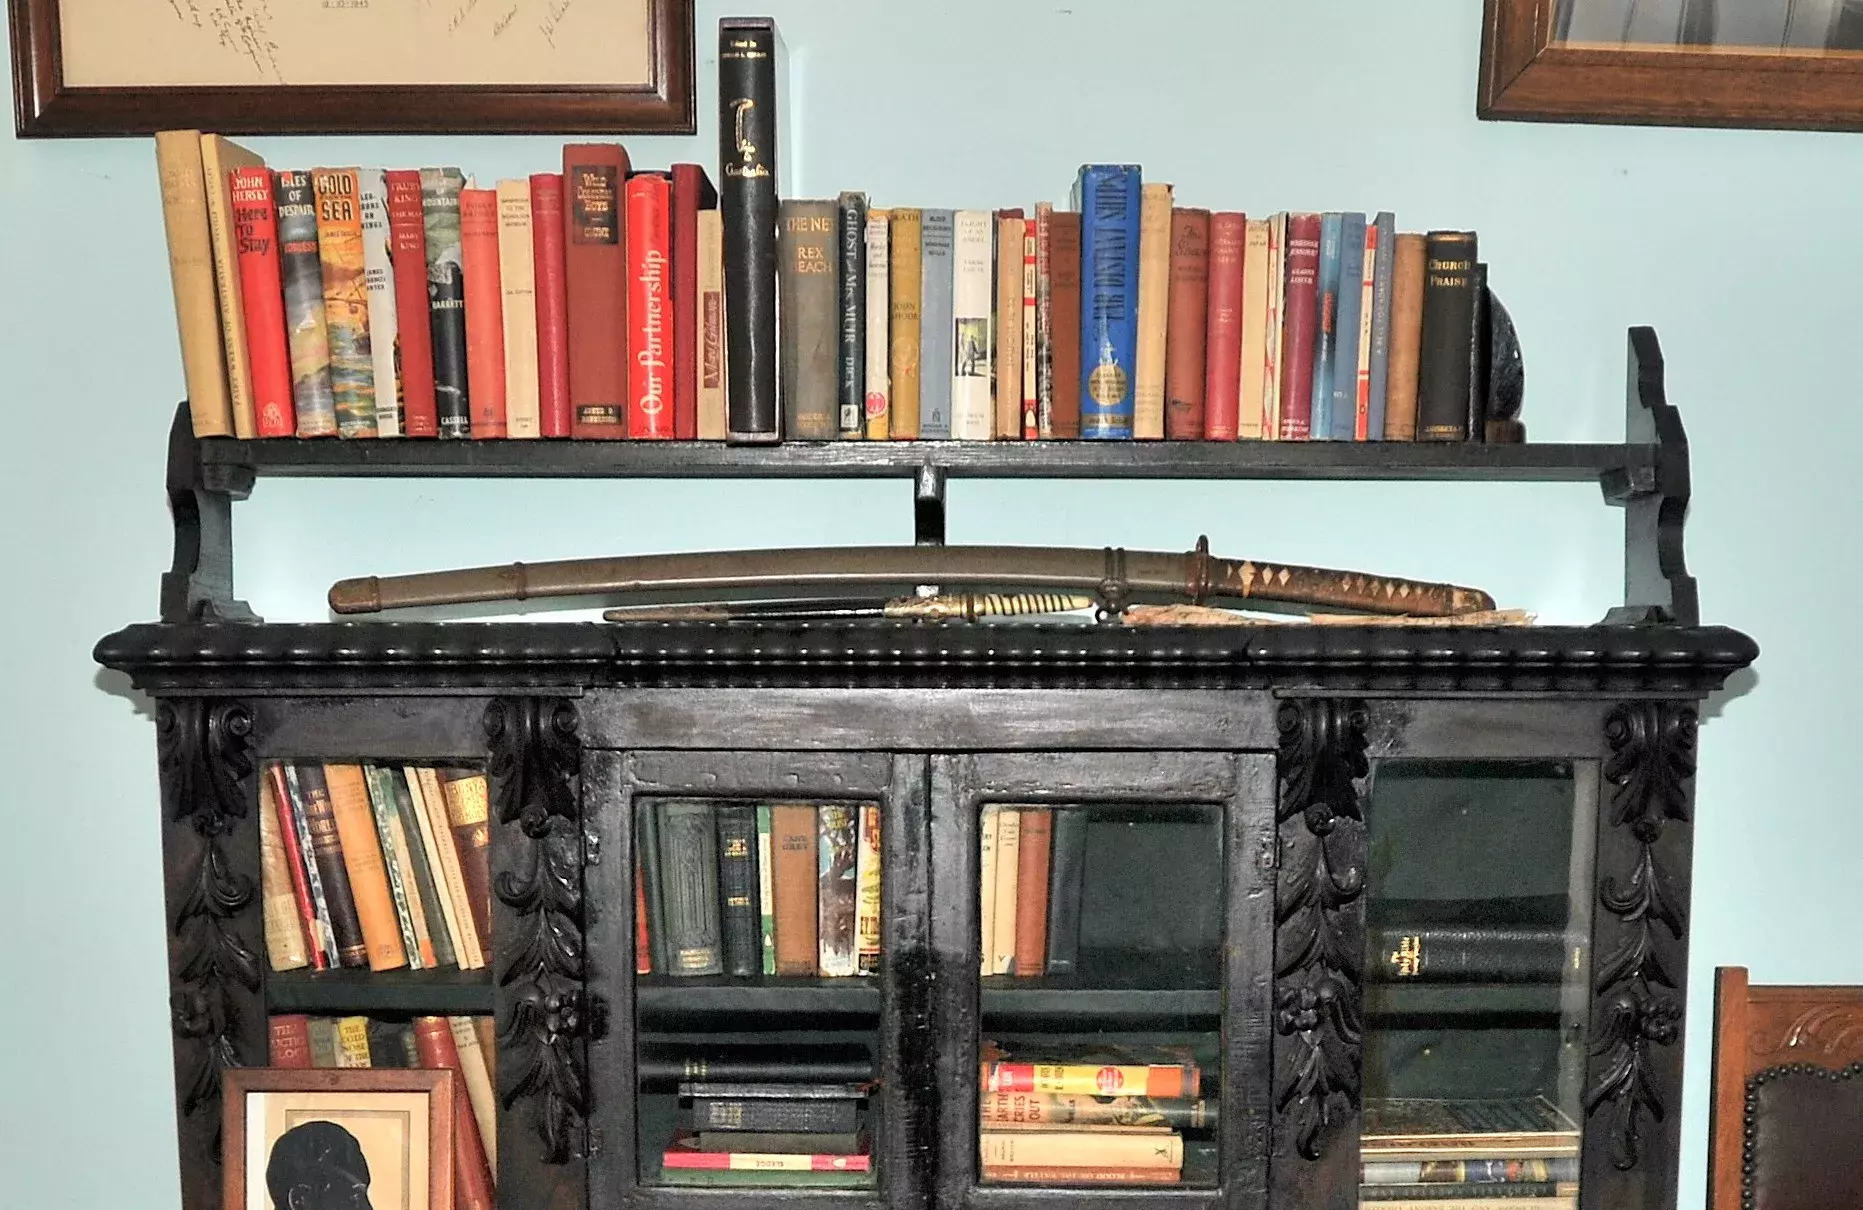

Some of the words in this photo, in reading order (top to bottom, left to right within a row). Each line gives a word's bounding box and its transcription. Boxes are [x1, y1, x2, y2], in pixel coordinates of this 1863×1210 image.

[234, 176, 263, 190] JOHN
[318, 174, 352, 195] GOLD
[288, 190, 302, 202] OF
[585, 201, 609, 211] BOYS
[1095, 175, 1127, 221] SHIPS
[278, 204, 316, 219] DESPAIR
[321, 200, 353, 221] SEA
[787, 217, 808, 232] THE
[845, 209, 858, 260] GHOST
[239, 237, 271, 256] Stay
[798, 246, 824, 259] REX
[1429, 259, 1471, 270] CHURCH
[637, 250, 668, 367] Partnership
[844, 305, 857, 343] MUIR
[844, 357, 856, 388] DICK
[639, 373, 664, 415] Our
[1029, 1099, 1041, 1121] OUT
